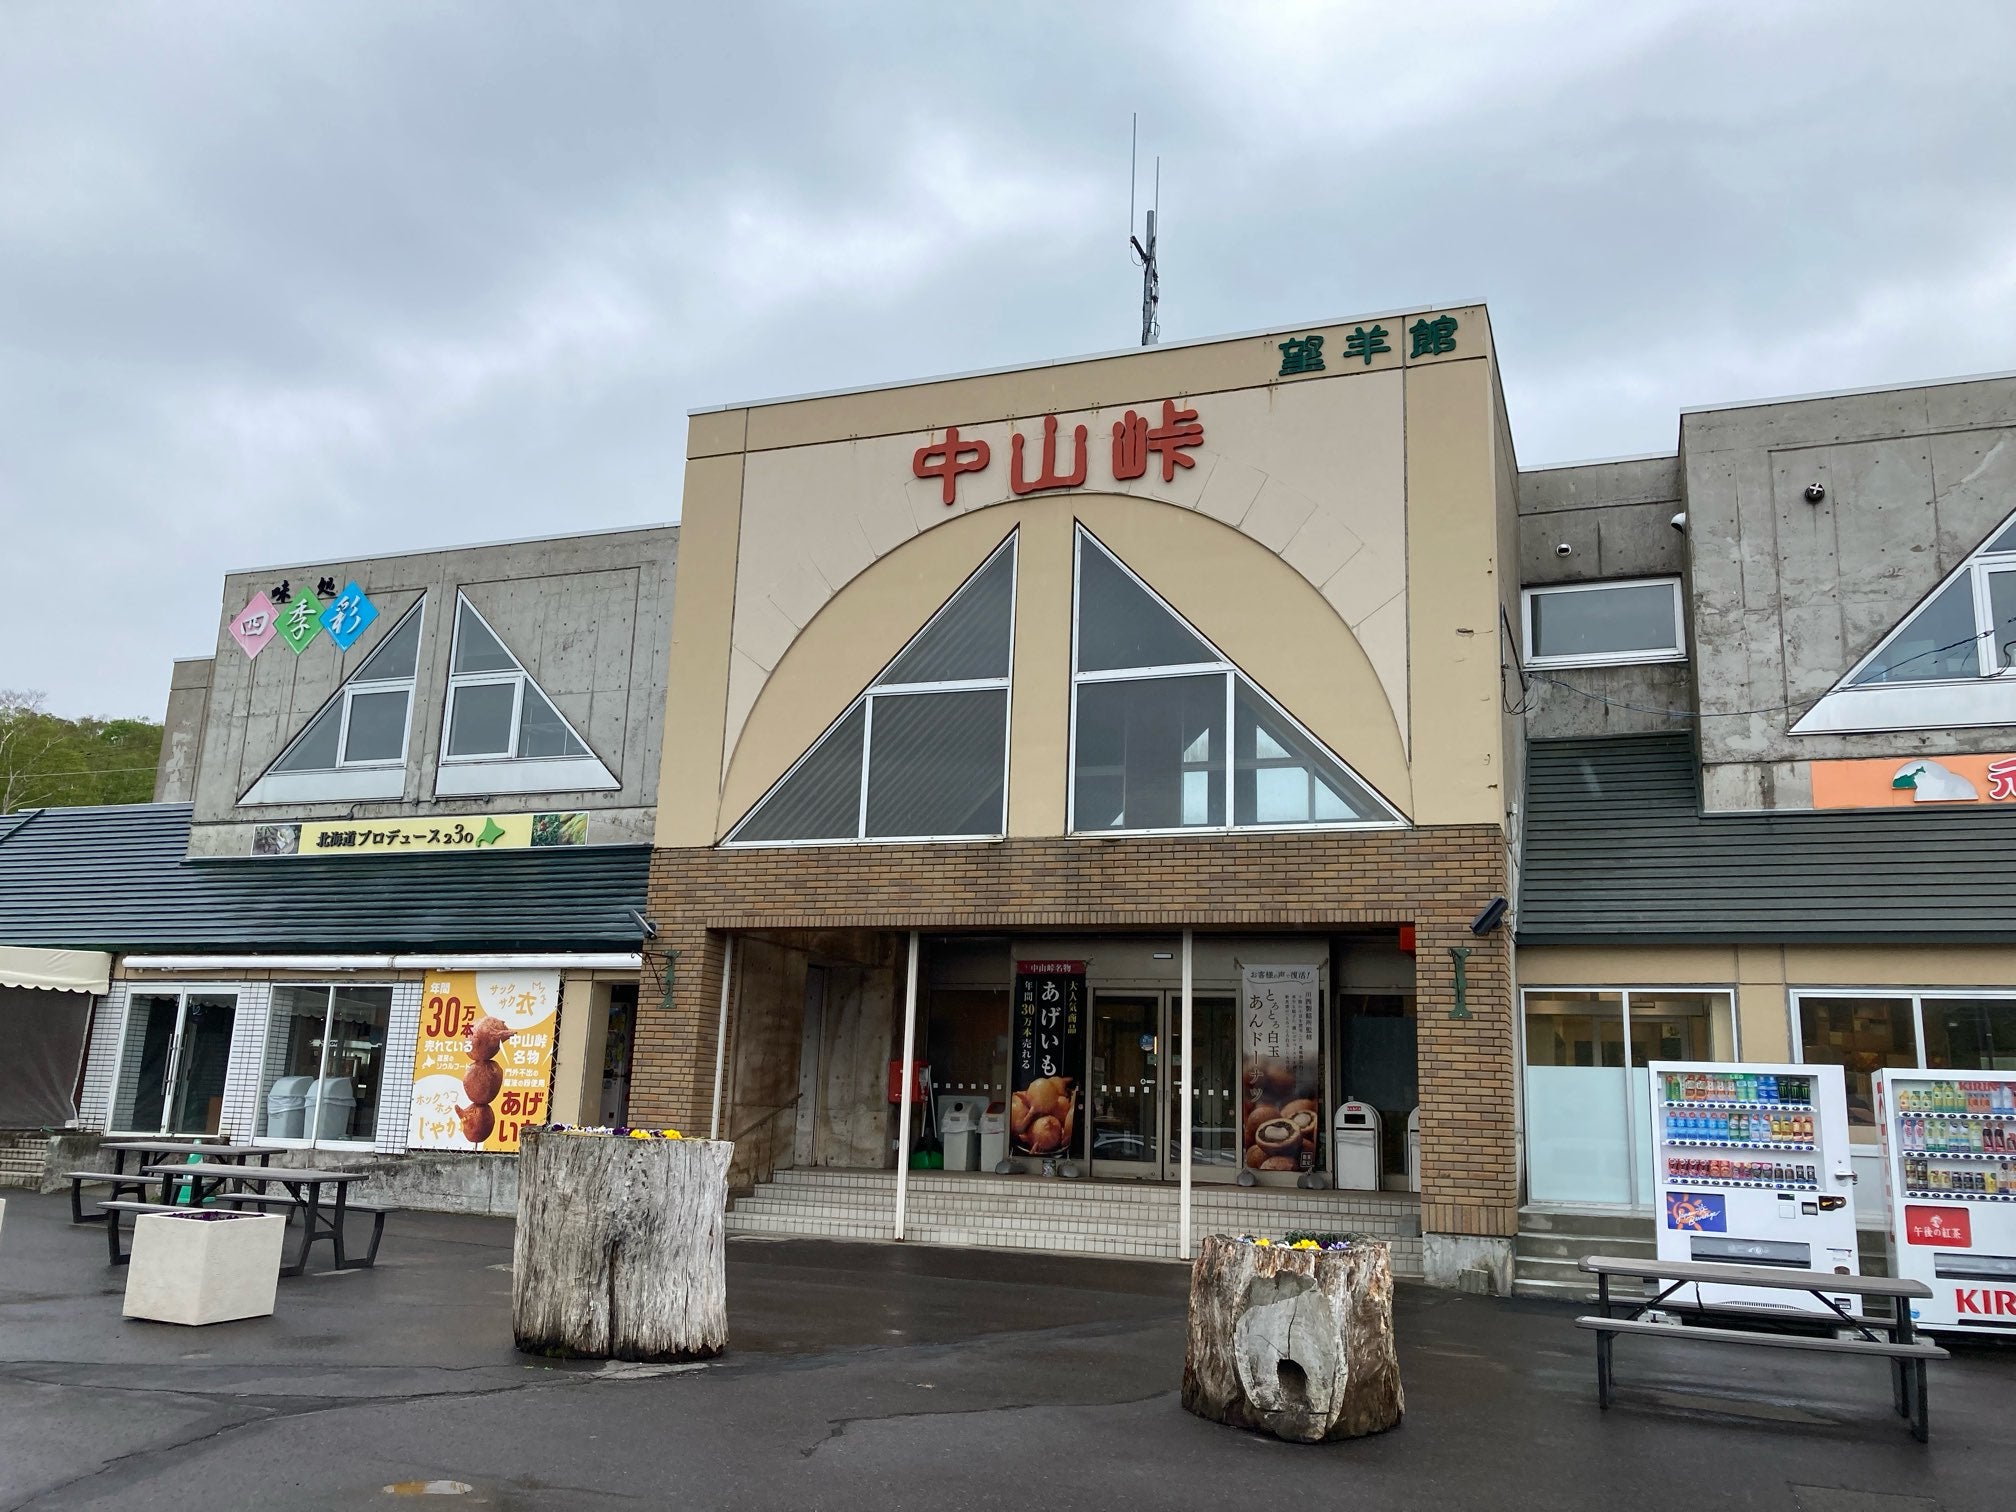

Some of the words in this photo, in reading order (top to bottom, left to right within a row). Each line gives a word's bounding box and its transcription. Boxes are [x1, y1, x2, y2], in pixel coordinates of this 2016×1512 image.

[1278, 314, 1458, 377] 望羊館
[912, 399, 1204, 505] 中山峠
[271, 576, 336, 603] 味処
[240, 595, 362, 641] 四季彩
[1030, 963, 1072, 973] 中山峠名物
[429, 982, 451, 995] 年間
[426, 996, 461, 1038] 30
[515, 991, 537, 1016] 衣
[1067, 980, 1078, 1035] 大人気商品
[1041, 981, 1061, 1076] あげいも
[1265, 988, 1280, 1058] とろとろ白玉
[424, 1040, 473, 1052] 売れている
[509, 1034, 548, 1048] 中山峠
[1249, 994, 1264, 1102] あんドーナツ
[513, 1050, 540, 1065] 名物
[501, 1091, 544, 1116] あげ
[1913, 1226, 1962, 1239] 午後の紅茶
